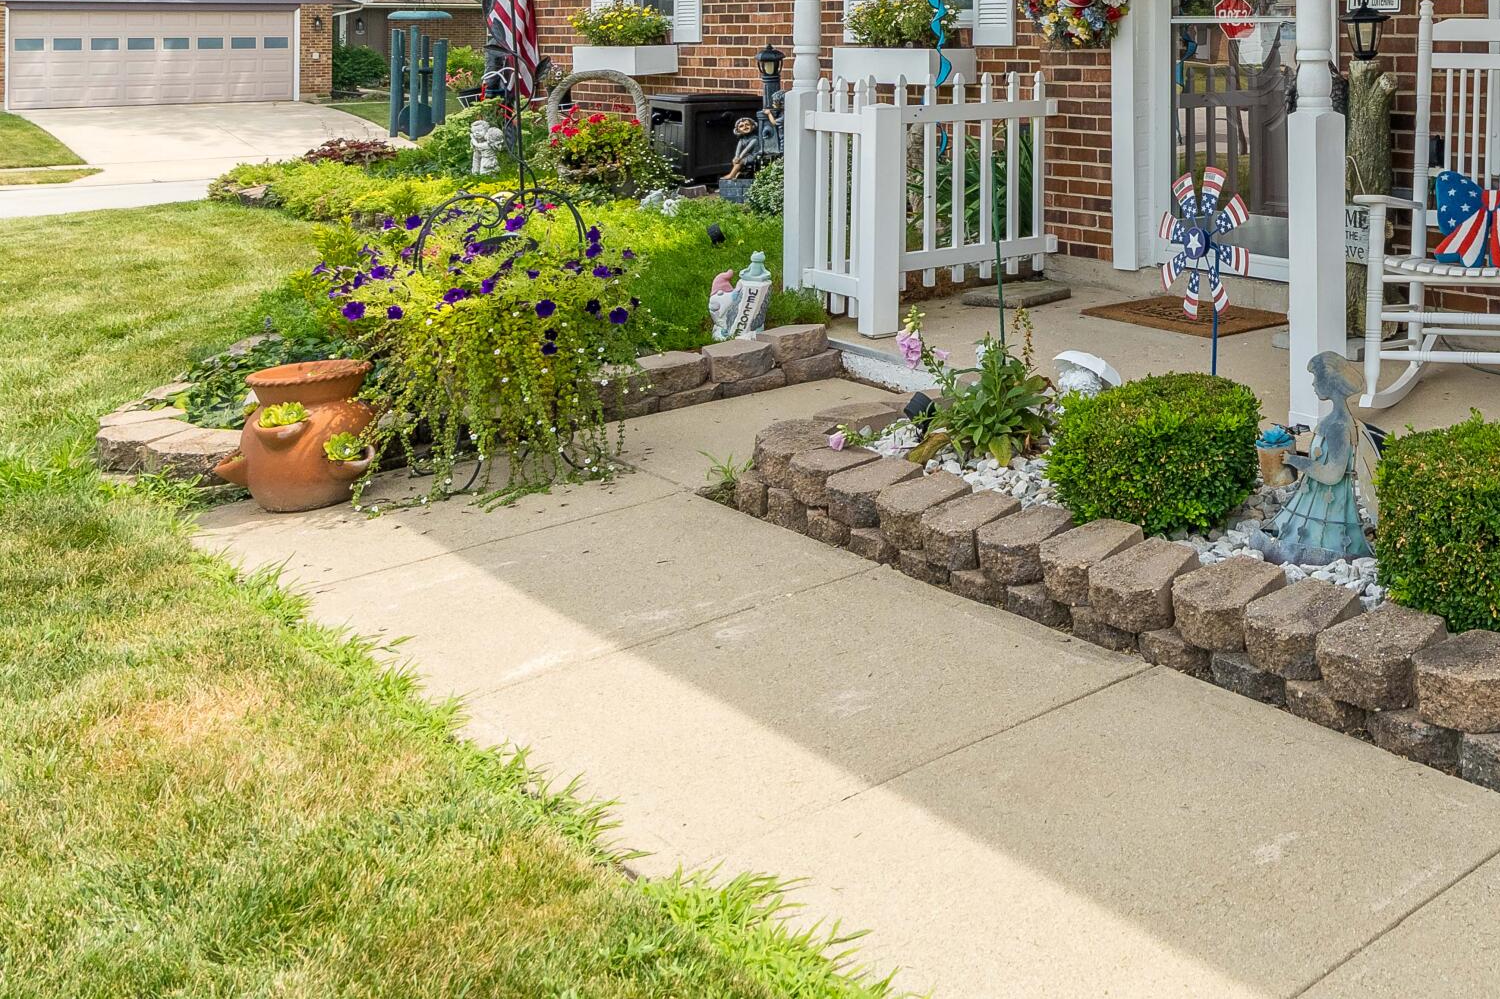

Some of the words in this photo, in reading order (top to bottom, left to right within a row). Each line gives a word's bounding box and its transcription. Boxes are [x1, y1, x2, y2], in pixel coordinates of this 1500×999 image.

[1345, 208, 1369, 230] ME
[1345, 244, 1365, 260] ave
[733, 288, 759, 337] WELCOME
